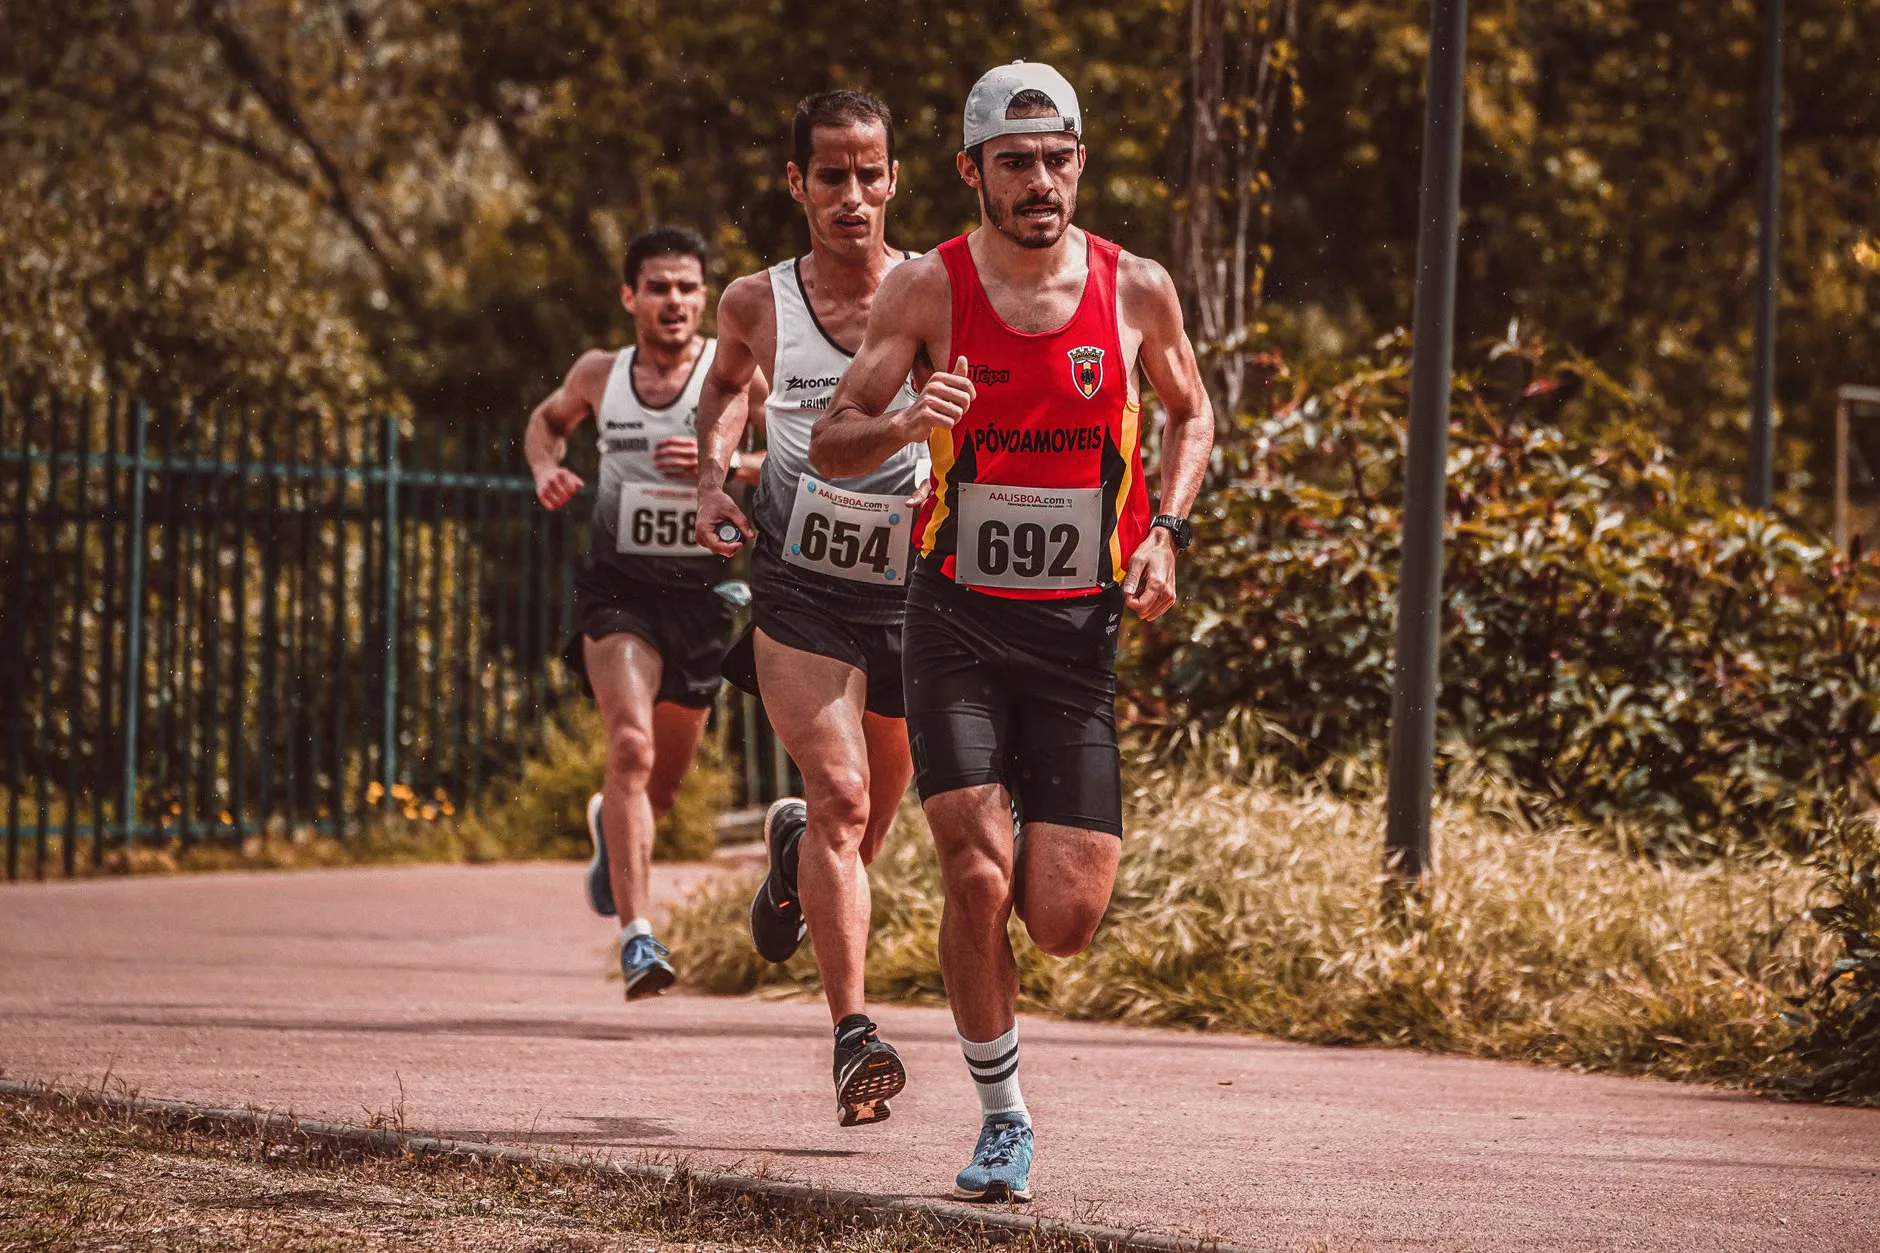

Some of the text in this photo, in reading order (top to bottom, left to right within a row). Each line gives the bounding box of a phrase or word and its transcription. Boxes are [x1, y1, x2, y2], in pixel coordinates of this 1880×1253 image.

[818, 489, 882, 509] AALISBOA.com
[989, 492, 1065, 504] AALISBOA.com
[632, 508, 697, 547] 658
[800, 512, 891, 574] 654
[977, 520, 1080, 578] 692
